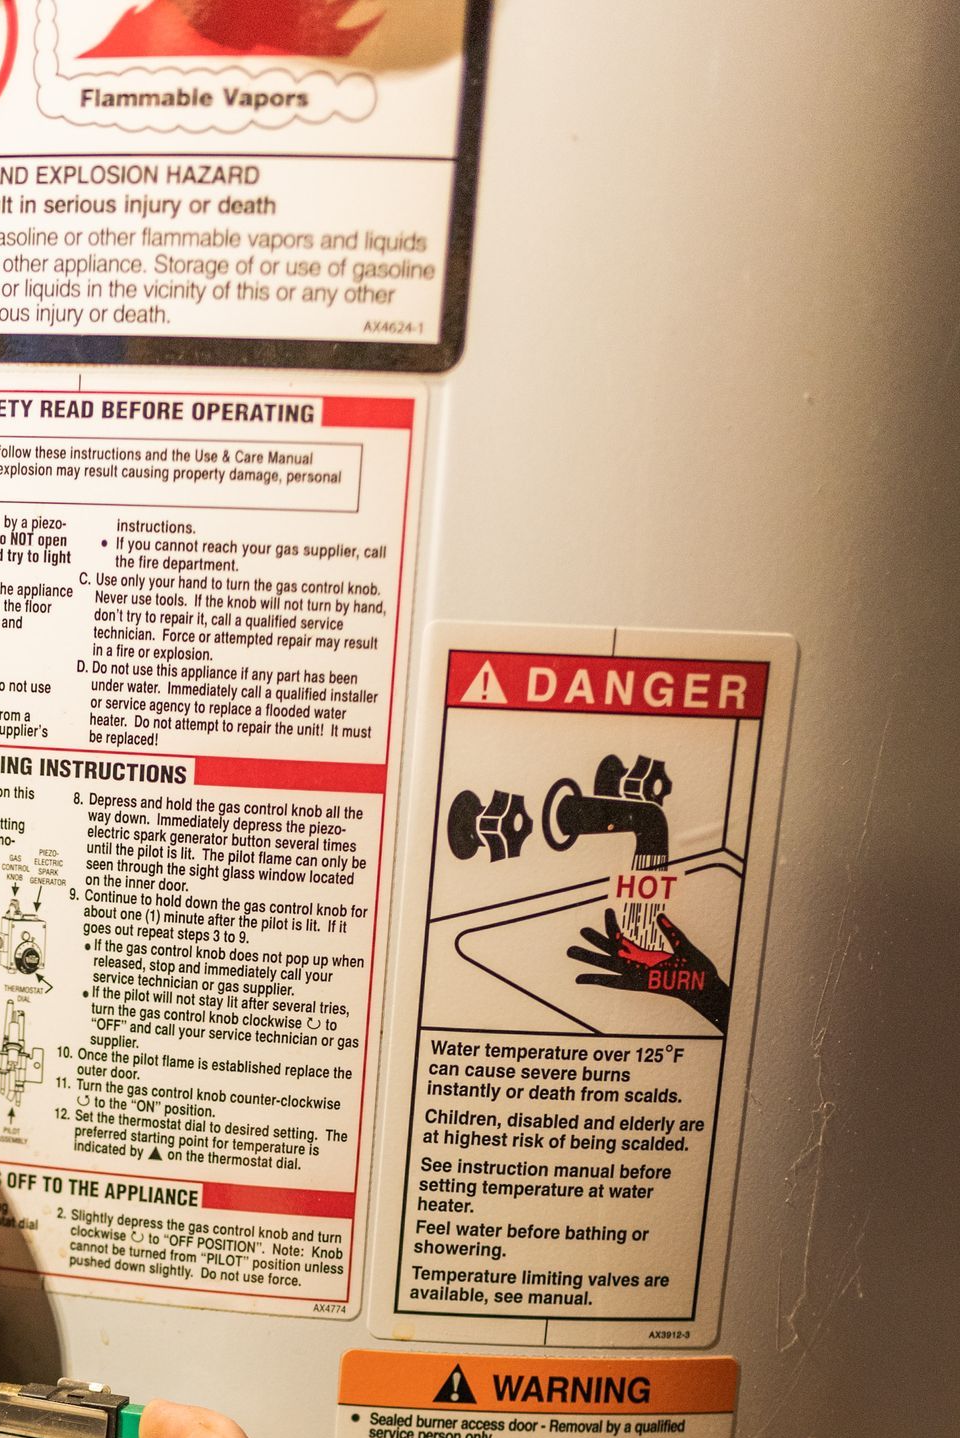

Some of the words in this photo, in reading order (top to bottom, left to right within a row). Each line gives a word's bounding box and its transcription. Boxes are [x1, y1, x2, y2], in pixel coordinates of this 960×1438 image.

[79, 88, 214, 108] Flammable
[222, 88, 310, 112] Vapors
[35, 166, 159, 187] EXPLOSION
[165, 165, 261, 186] HAZARD
[19, 194, 36, 215] in
[43, 194, 117, 215] serious
[124, 194, 181, 220] injury
[188, 199, 211, 215] or
[217, 195, 276, 216] death
[63, 232, 83, 248] or
[87, 228, 137, 248] other
[140, 228, 242, 249] flammable
[246, 233, 315, 255] vapors
[319, 231, 359, 251] and
[363, 231, 428, 257] liquids
[35, 303, 83, 327] injury
[88, 307, 105, 323] or
[112, 304, 171, 325] death.
[361, 321, 424, 335] AX4624-1
[39, 400, 94, 421] READ
[100, 400, 184, 422] BEFORE
[190, 401, 315, 424] OPERATING
[34, 446, 67, 460] these
[69, 446, 142, 462] instructions
[144, 448, 168, 462] and
[170, 448, 191, 463] the
[194, 449, 218, 463] Use
[221, 449, 231, 464] &
[233, 450, 264, 464] Care
[266, 450, 314, 465] Manual
[115, 520, 196, 535] instructions.
[114, 554, 135, 568] the
[137, 555, 159, 569] fire
[161, 556, 239, 575] department.
[526, 667, 749, 711] DANGER
[87, 730, 103, 745] be
[104, 731, 159, 750] replaced!
[38, 756, 188, 785] INSTRUCTIONS
[9, 854, 22, 863] GAS
[34, 859, 64, 868] ELECTRIC
[39, 849, 60, 858] PIEZO-
[2, 864, 30, 873] CONTROL
[6, 873, 23, 882] KNOB
[38, 868, 59, 877] SPARK
[30, 877, 67, 887] GENERATOR
[615, 874, 677, 900] HOT
[4, 984, 44, 995] THERMOSTAT
[647, 969, 705, 992] BURN
[17, 995, 31, 1003] DIAL
[88, 1030, 139, 1050] supplier.
[429, 1038, 481, 1057] Water
[483, 1040, 589, 1065] temperature
[591, 1047, 631, 1062] over
[634, 1045, 685, 1064] 125°F
[76, 1063, 107, 1078] outer
[109, 1064, 140, 1080] door.
[427, 1062, 460, 1077] can
[463, 1063, 516, 1078] cause
[519, 1065, 578, 1080] severe
[581, 1063, 631, 1082] burns
[425, 1077, 502, 1101] instantly
[504, 1084, 525, 1098] or
[527, 1081, 576, 1100] death
[579, 1083, 620, 1101] from
[621, 1084, 683, 1104] scalds.
[3, 1126, 20, 1135] PILOT
[423, 1107, 502, 1129] Children,
[506, 1109, 580, 1129] disabled
[582, 1111, 616, 1130] and
[618, 1112, 676, 1135] elderly
[678, 1117, 705, 1132] are
[5, 1171, 37, 1191] OFF
[43, 1175, 63, 1194] TO
[69, 1177, 99, 1197] THE
[104, 1181, 199, 1206] APPLIANCE
[416, 1195, 475, 1213] heater.
[412, 1238, 507, 1262] showering.
[68, 1252, 111, 1273] pushed
[113, 1256, 145, 1273] down
[148, 1259, 193, 1280] slightly.
[200, 1264, 217, 1279] Do
[219, 1265, 239, 1281] not
[242, 1270, 264, 1283] use
[267, 1269, 301, 1286] force.
[408, 1283, 489, 1304] available,
[492, 1289, 524, 1303] see
[526, 1286, 593, 1305] manual.
[311, 1302, 346, 1313] AX4774
[647, 1329, 691, 1339] AX3912-3
[489, 1374, 654, 1405] WARNING
[368, 1413, 413, 1428] Sealed
[414, 1415, 459, 1429] burner
[459, 1419, 506, 1431] access
[507, 1417, 539, 1431] door
[548, 1418, 604, 1432] Removal
[604, 1419, 622, 1435] by
[622, 1422, 632, 1433] a
[633, 1419, 686, 1435] qualified
